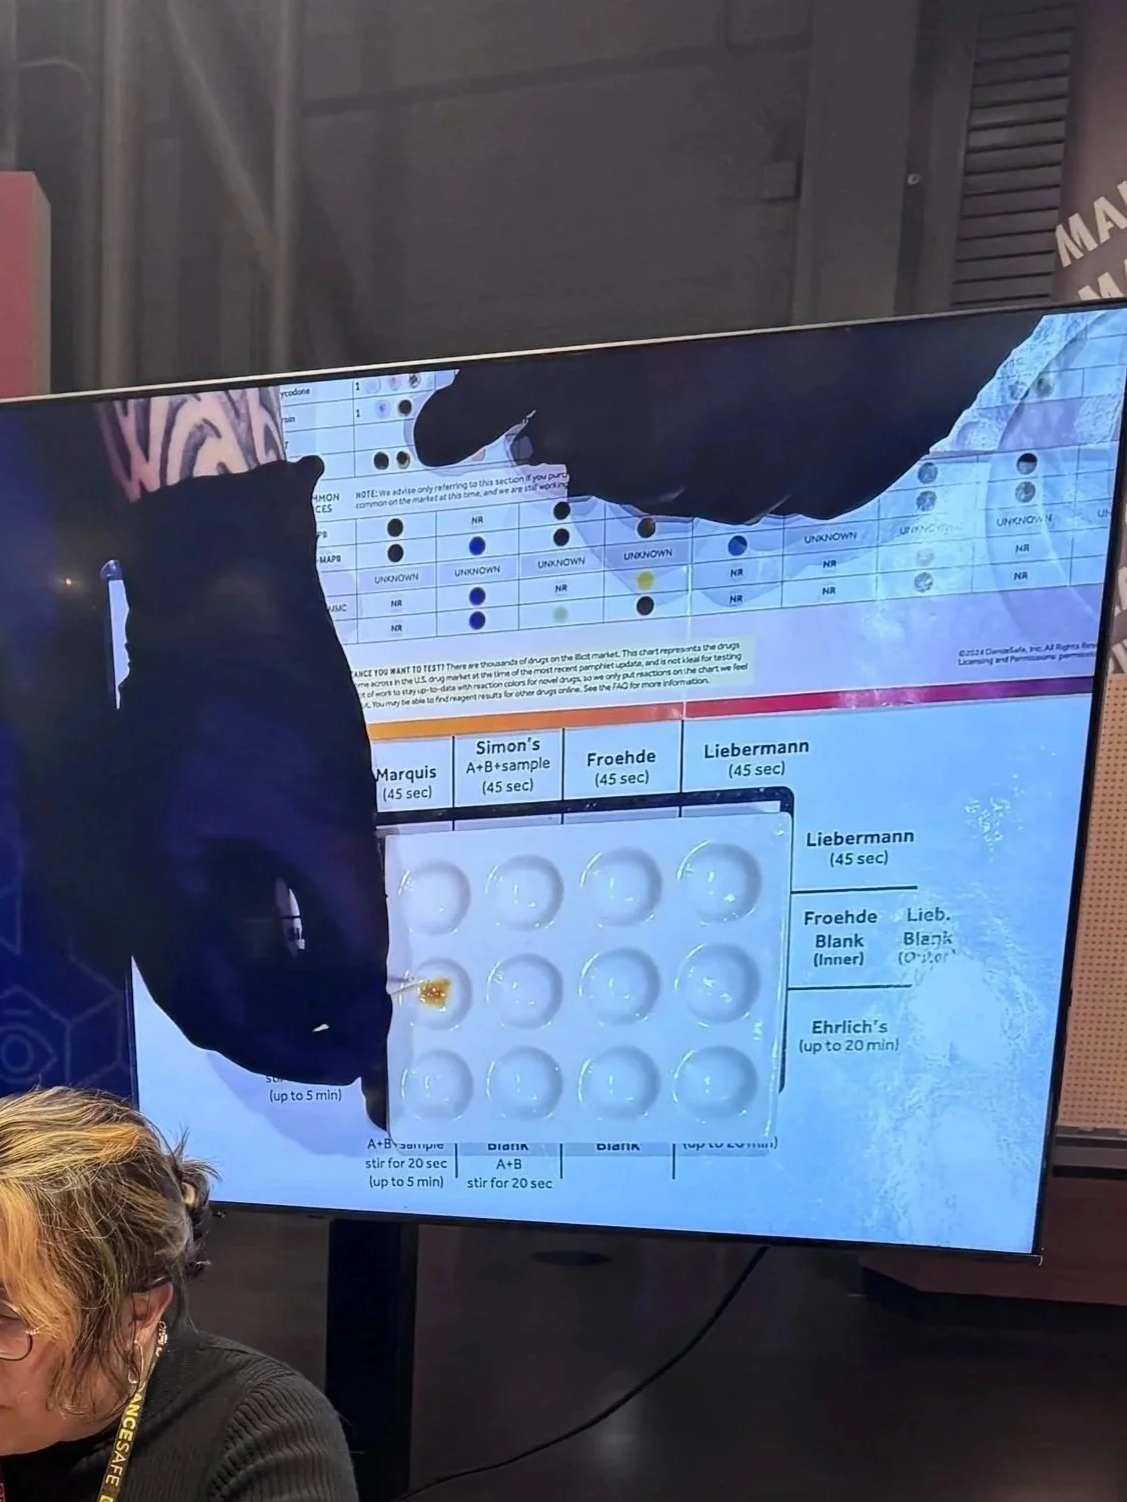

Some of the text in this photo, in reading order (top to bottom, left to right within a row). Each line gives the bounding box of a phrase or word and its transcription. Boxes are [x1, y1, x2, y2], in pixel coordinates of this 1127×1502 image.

[379, 489, 391, 497] We
[392, 486, 416, 496] advise
[418, 485, 433, 495] only
[434, 482, 468, 493] referring
[478, 479, 493, 487] this
[495, 475, 523, 486] section
[532, 474, 547, 483] you
[471, 516, 483, 524] NR
[804, 532, 857, 544] UNKNOWN
[624, 548, 672, 560] UNKNOWN
[538, 557, 585, 568] UNKNOWN
[823, 560, 837, 568] NR
[374, 573, 419, 583] UNKNOWN
[454, 565, 500, 576] UNKNOWN
[730, 569, 743, 577] NR
[555, 584, 568, 593] NR
[822, 587, 836, 595] NR
[391, 599, 403, 608] NR
[729, 595, 743, 603] NR
[391, 624, 403, 633] NR
[374, 668, 388, 677] YOU
[390, 666, 410, 675] WANT
[412, 665, 422, 674] TO
[423, 663, 445, 673] TEST?
[446, 662, 467, 671] There
[480, 658, 518, 668] thousands
[519, 657, 527, 665] of
[528, 656, 549, 667] drugs
[561, 654, 573, 662] the
[591, 651, 620, 660] market.
[622, 649, 637, 658] This
[638, 647, 659, 657] chart
[660, 644, 701, 656] represents
[702, 643, 715, 651] the
[717, 641, 740, 652] drugs
[476, 737, 540, 755] Simon's
[704, 741, 809, 759] Liebermann
[587, 749, 656, 767] Froehde
[466, 757, 551, 775] A+B+sample
[728, 761, 785, 779] (45 sec)
[376, 765, 437, 783] Marquis
[594, 769, 649, 788] (45 sec)
[383, 785, 432, 802] (45 sec)
[481, 778, 534, 796] (45 sec)
[806, 831, 914, 847] Liebermann
[830, 850, 889, 867] (45 sec)
[804, 909, 878, 925] Froehde
[907, 907, 951, 922] Lieb.
[815, 934, 864, 948] Blank
[903, 931, 953, 946] Blank
[813, 952, 864, 967] (Inner)
[812, 1020, 888, 1034] Ehrlich's
[799, 1038, 899, 1054] (up to 20 min)
[269, 1088, 342, 1103] (up to 5 min)
[365, 1158, 447, 1169] stir for 20 sec
[496, 1159, 523, 1170] A+B
[369, 1175, 444, 1189] (up to 5 min)
[467, 1177, 553, 1189] stir for 20 sec
[105, 1381, 146, 1488] ANCESAFE
